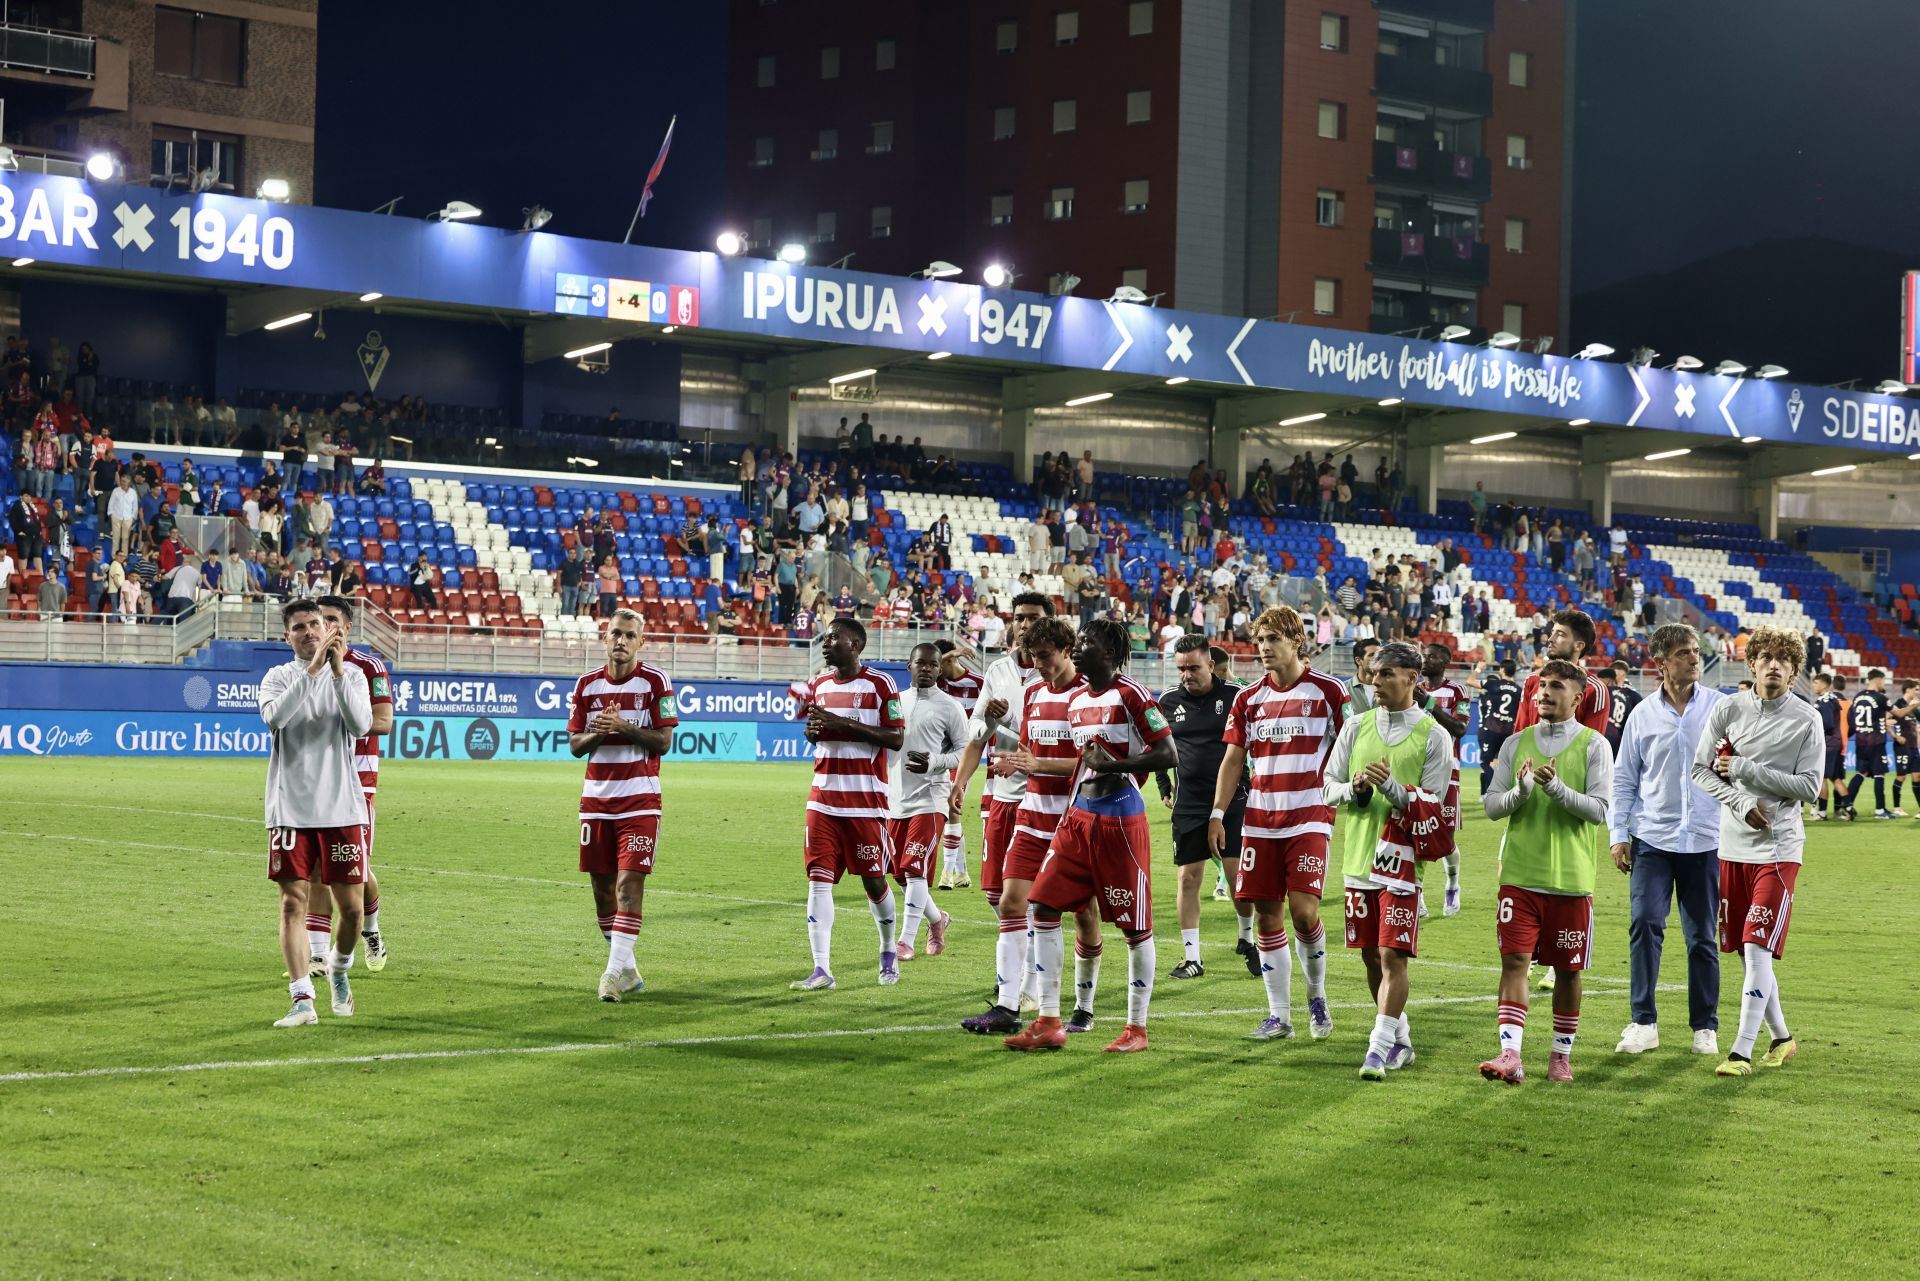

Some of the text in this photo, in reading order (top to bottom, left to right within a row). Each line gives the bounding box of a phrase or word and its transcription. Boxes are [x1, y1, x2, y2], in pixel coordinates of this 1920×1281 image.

[169, 207, 294, 270] 1940
[592, 284, 606, 307] 3
[652, 291, 666, 314] 0
[743, 272, 1053, 349] IPURUA 1947
[1308, 338, 1393, 383] Another
[1398, 344, 1479, 397] football
[1481, 360, 1501, 389] is
[419, 681, 518, 703] UNCETA 1874
[217, 700, 258, 708] METROLOGIA
[418, 703, 518, 714] HERRAMIENTAS DE CALIDAD
[705, 690, 796, 721] smartlog
[1499, 693, 1512, 715] 2
[1612, 698, 1626, 723] 18
[1175, 714, 1186, 722] CM
[1855, 705, 1873, 726] 21
[115, 721, 187, 751] Gure
[379, 719, 450, 758] IGA
[471, 727, 493, 743] EA
[469, 742, 494, 751] SPORTS
[772, 738, 798, 757] zu
[271, 827, 297, 850] 20
[627, 845, 651, 853] GRUPO
[331, 854, 361, 862] GRUPO
[1297, 865, 1323, 875] GRUPO
[1107, 898, 1131, 907] RUPO
[1344, 891, 1368, 919] 33
[1496, 897, 1514, 923] 6
[1384, 917, 1412, 928] GRUPO
[1745, 914, 1770, 925] RUPO
[1556, 941, 1583, 949] GRUPO
